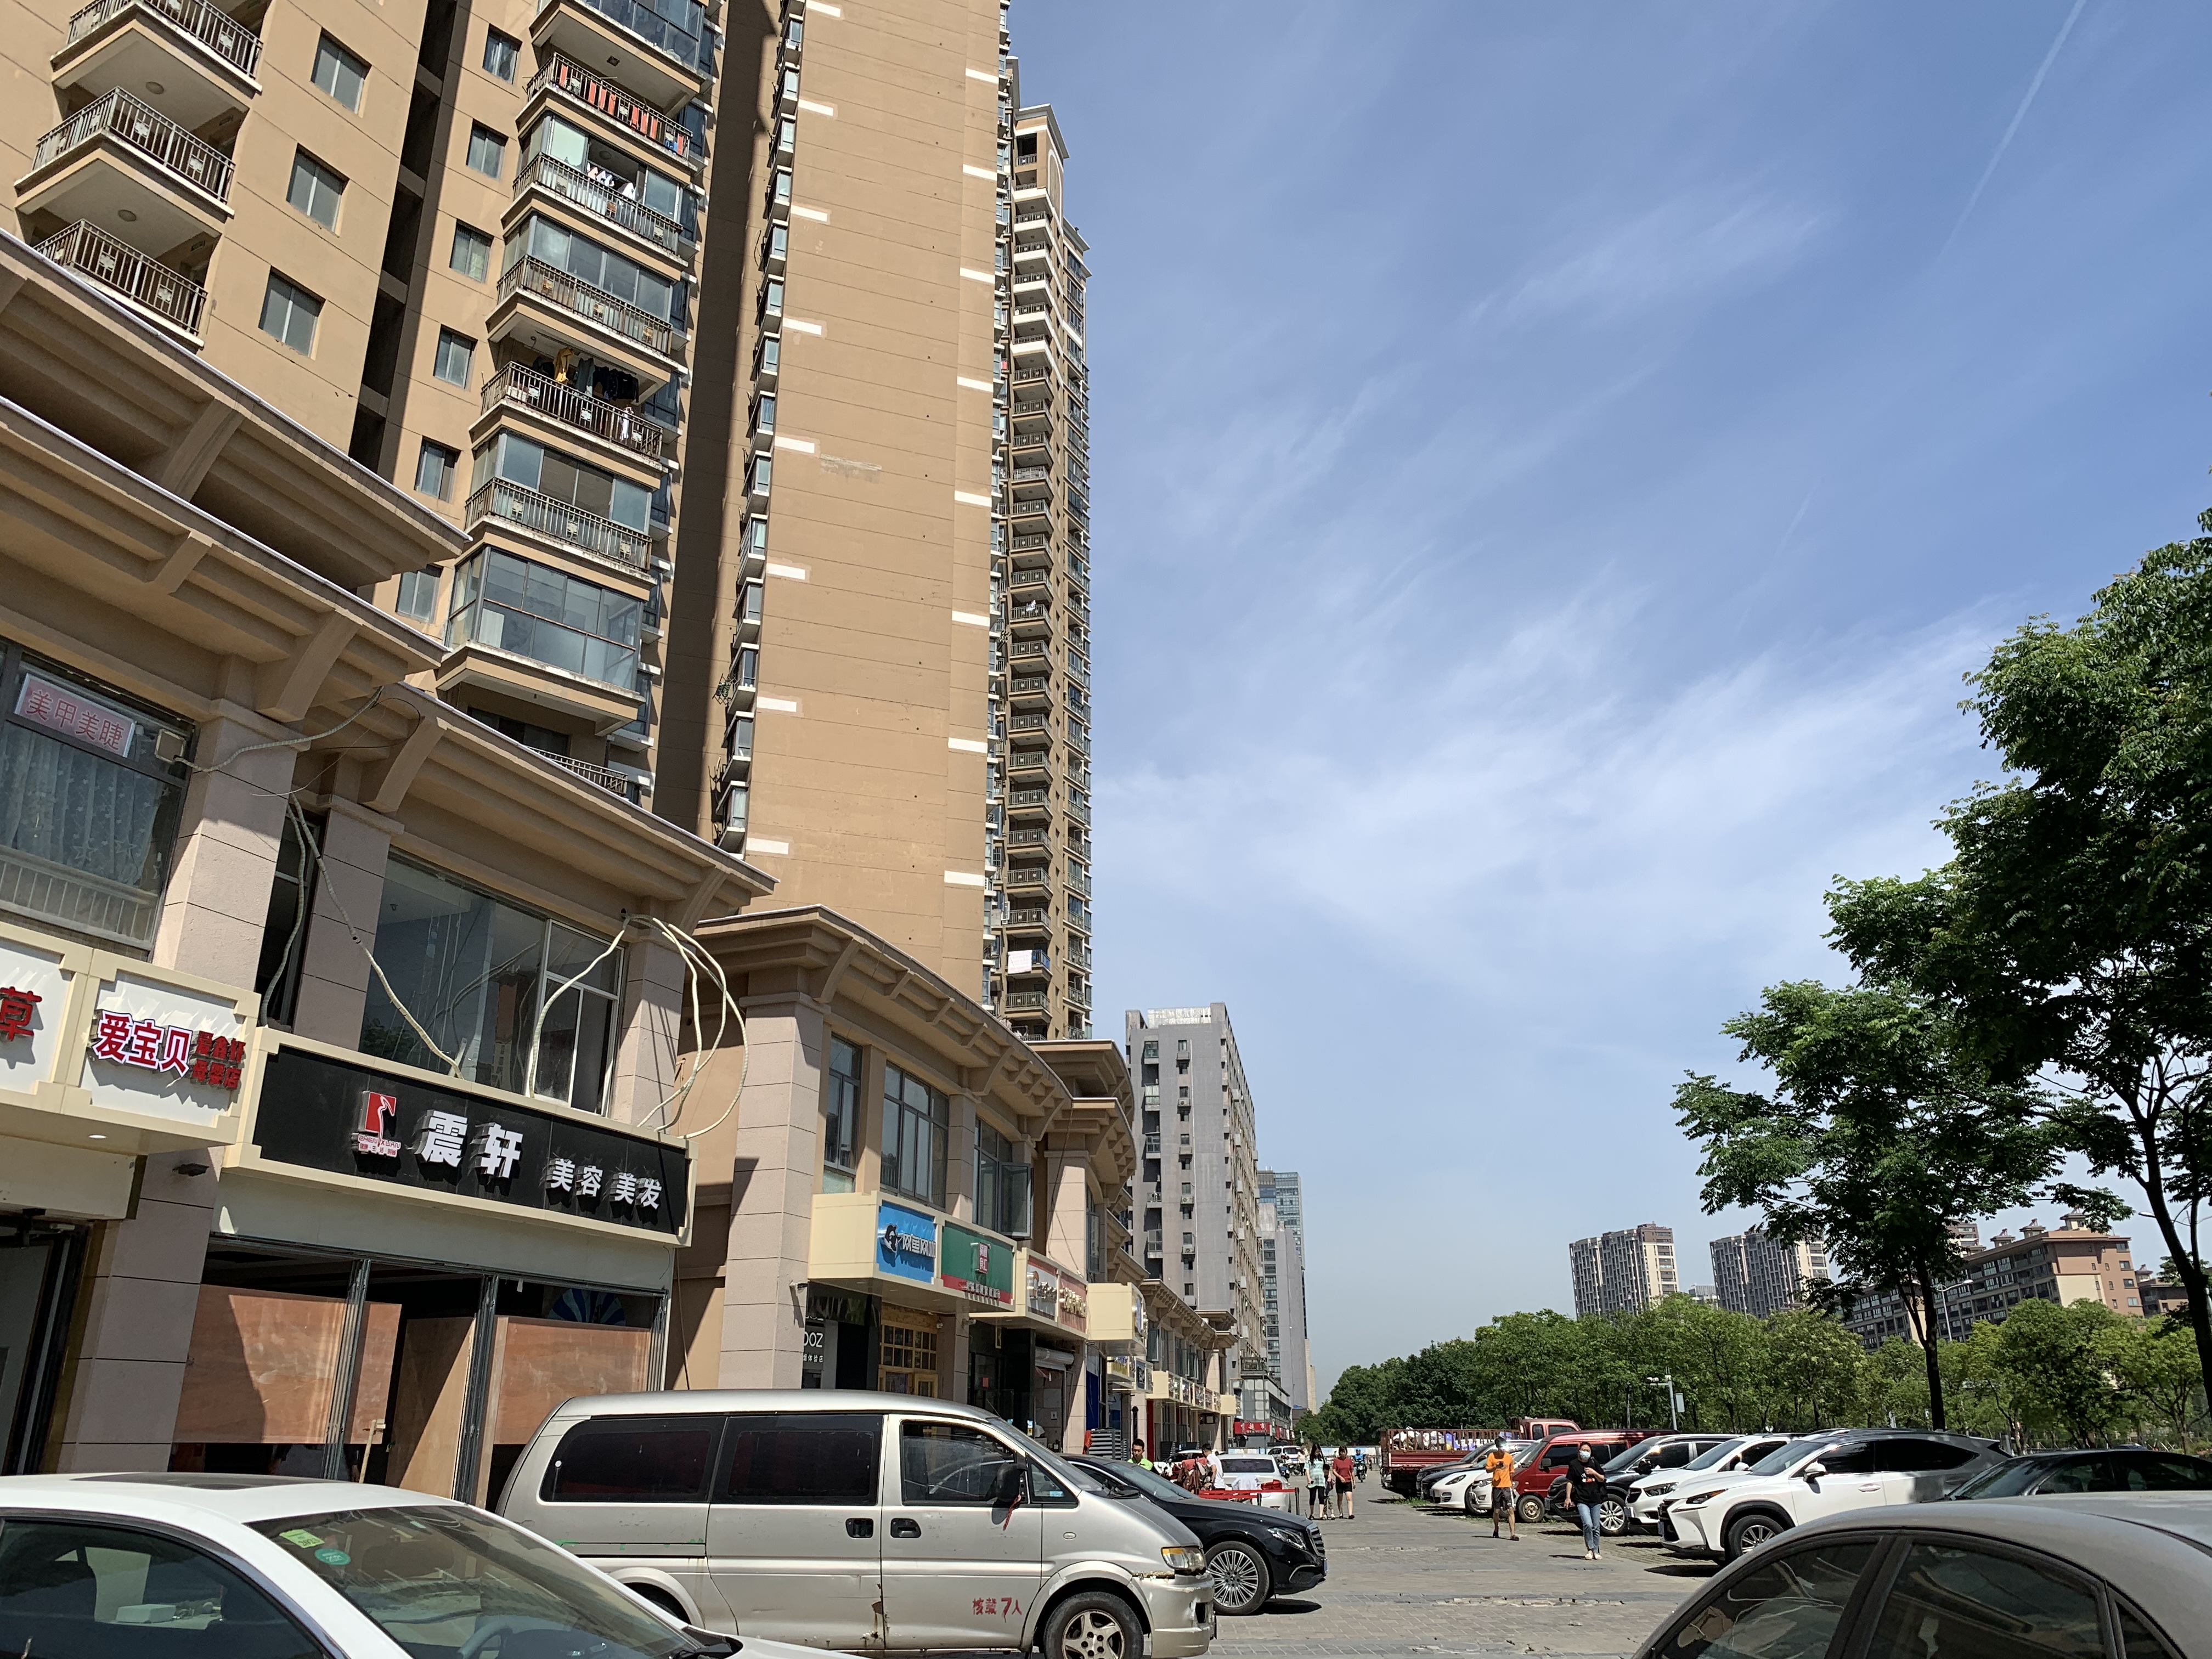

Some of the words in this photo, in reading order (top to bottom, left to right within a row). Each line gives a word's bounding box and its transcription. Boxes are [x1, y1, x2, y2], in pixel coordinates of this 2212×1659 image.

[26, 691, 125, 751] 美甲美睫
[0, 986, 42, 1041] 草
[92, 1011, 193, 1077] 爱宝贝
[381, 1140, 400, 1149] XUAN
[421, 1110, 523, 1178] 震轩
